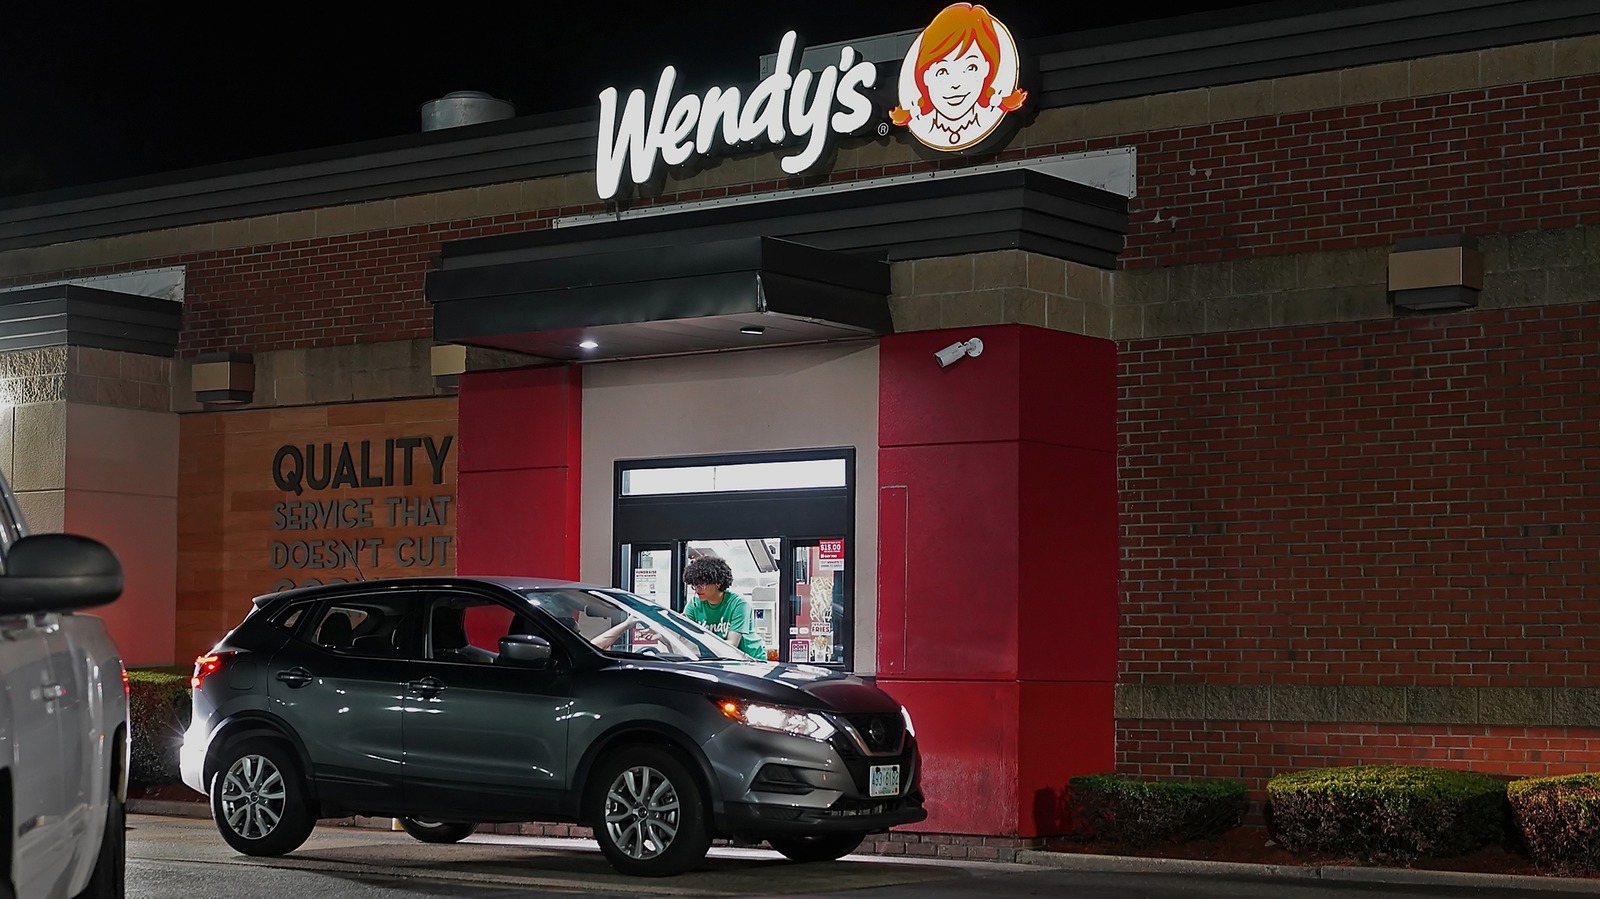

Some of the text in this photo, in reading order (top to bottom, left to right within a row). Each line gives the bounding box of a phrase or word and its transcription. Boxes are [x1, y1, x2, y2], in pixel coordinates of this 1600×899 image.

[597, 30, 877, 199] Wendy's
[272, 436, 453, 496] QUALITY
[272, 496, 453, 530] SERVICE THAT
[271, 536, 453, 569] DOESN'T CUT
